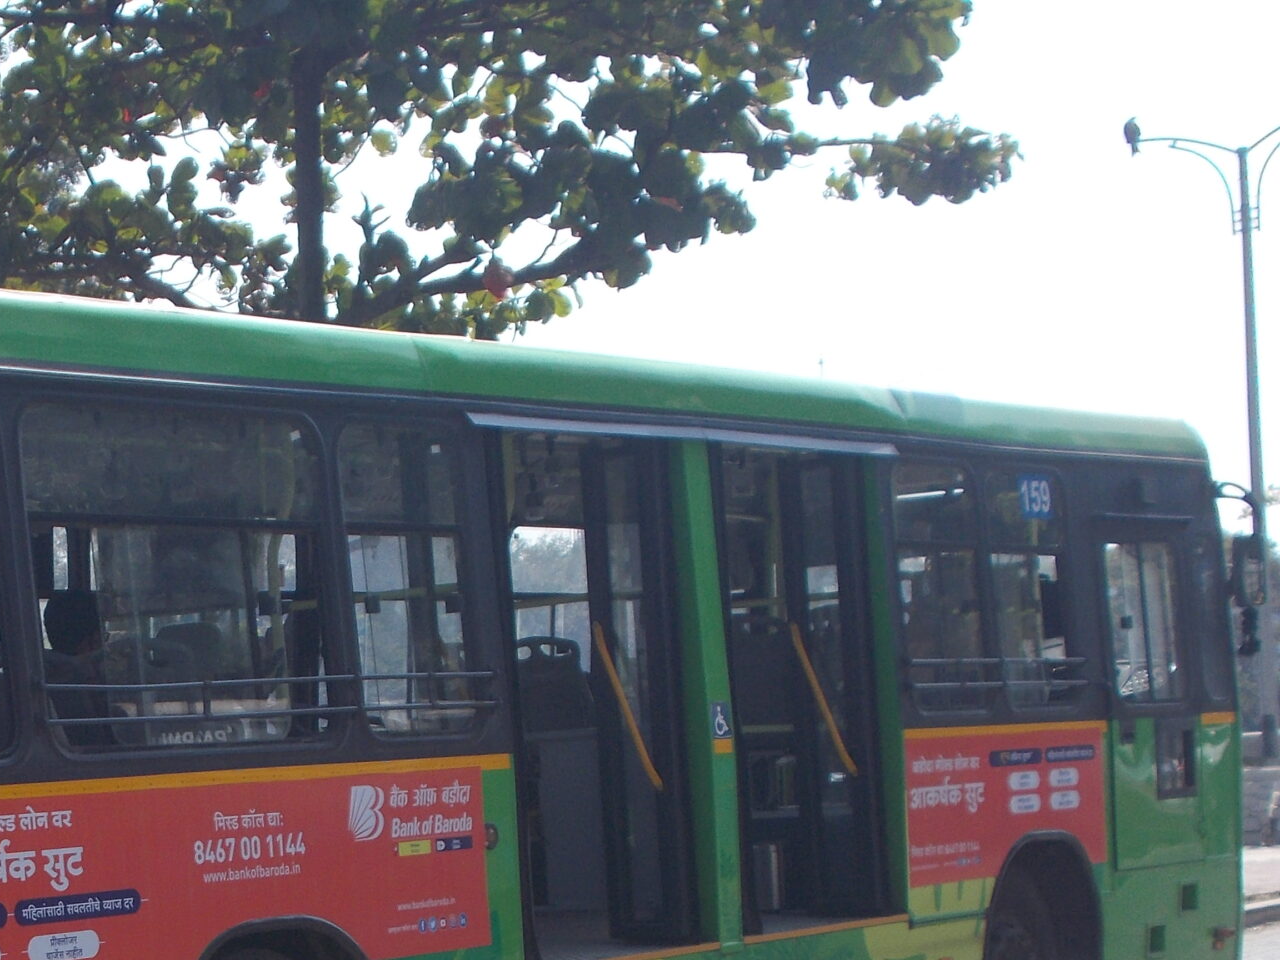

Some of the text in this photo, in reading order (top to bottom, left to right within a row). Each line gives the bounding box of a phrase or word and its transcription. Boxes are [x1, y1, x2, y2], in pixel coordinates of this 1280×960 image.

[1020, 479, 1051, 512] 159
[910, 776, 963, 810] आकर्षक
[19, 805, 48, 830] लोन
[51, 809, 72, 828] वर
[214, 811, 239, 832] मिस्ड
[241, 808, 264, 829] कॉल
[391, 811, 473, 838] Bank of Baroda
[194, 832, 306, 864] 8467 00 1144
[41, 846, 84, 892] सुट
[203, 862, 301, 883] www.bankofbaroda.in
[22, 897, 134, 921] महिलांसाठी सवलतीचे व्याज दर
